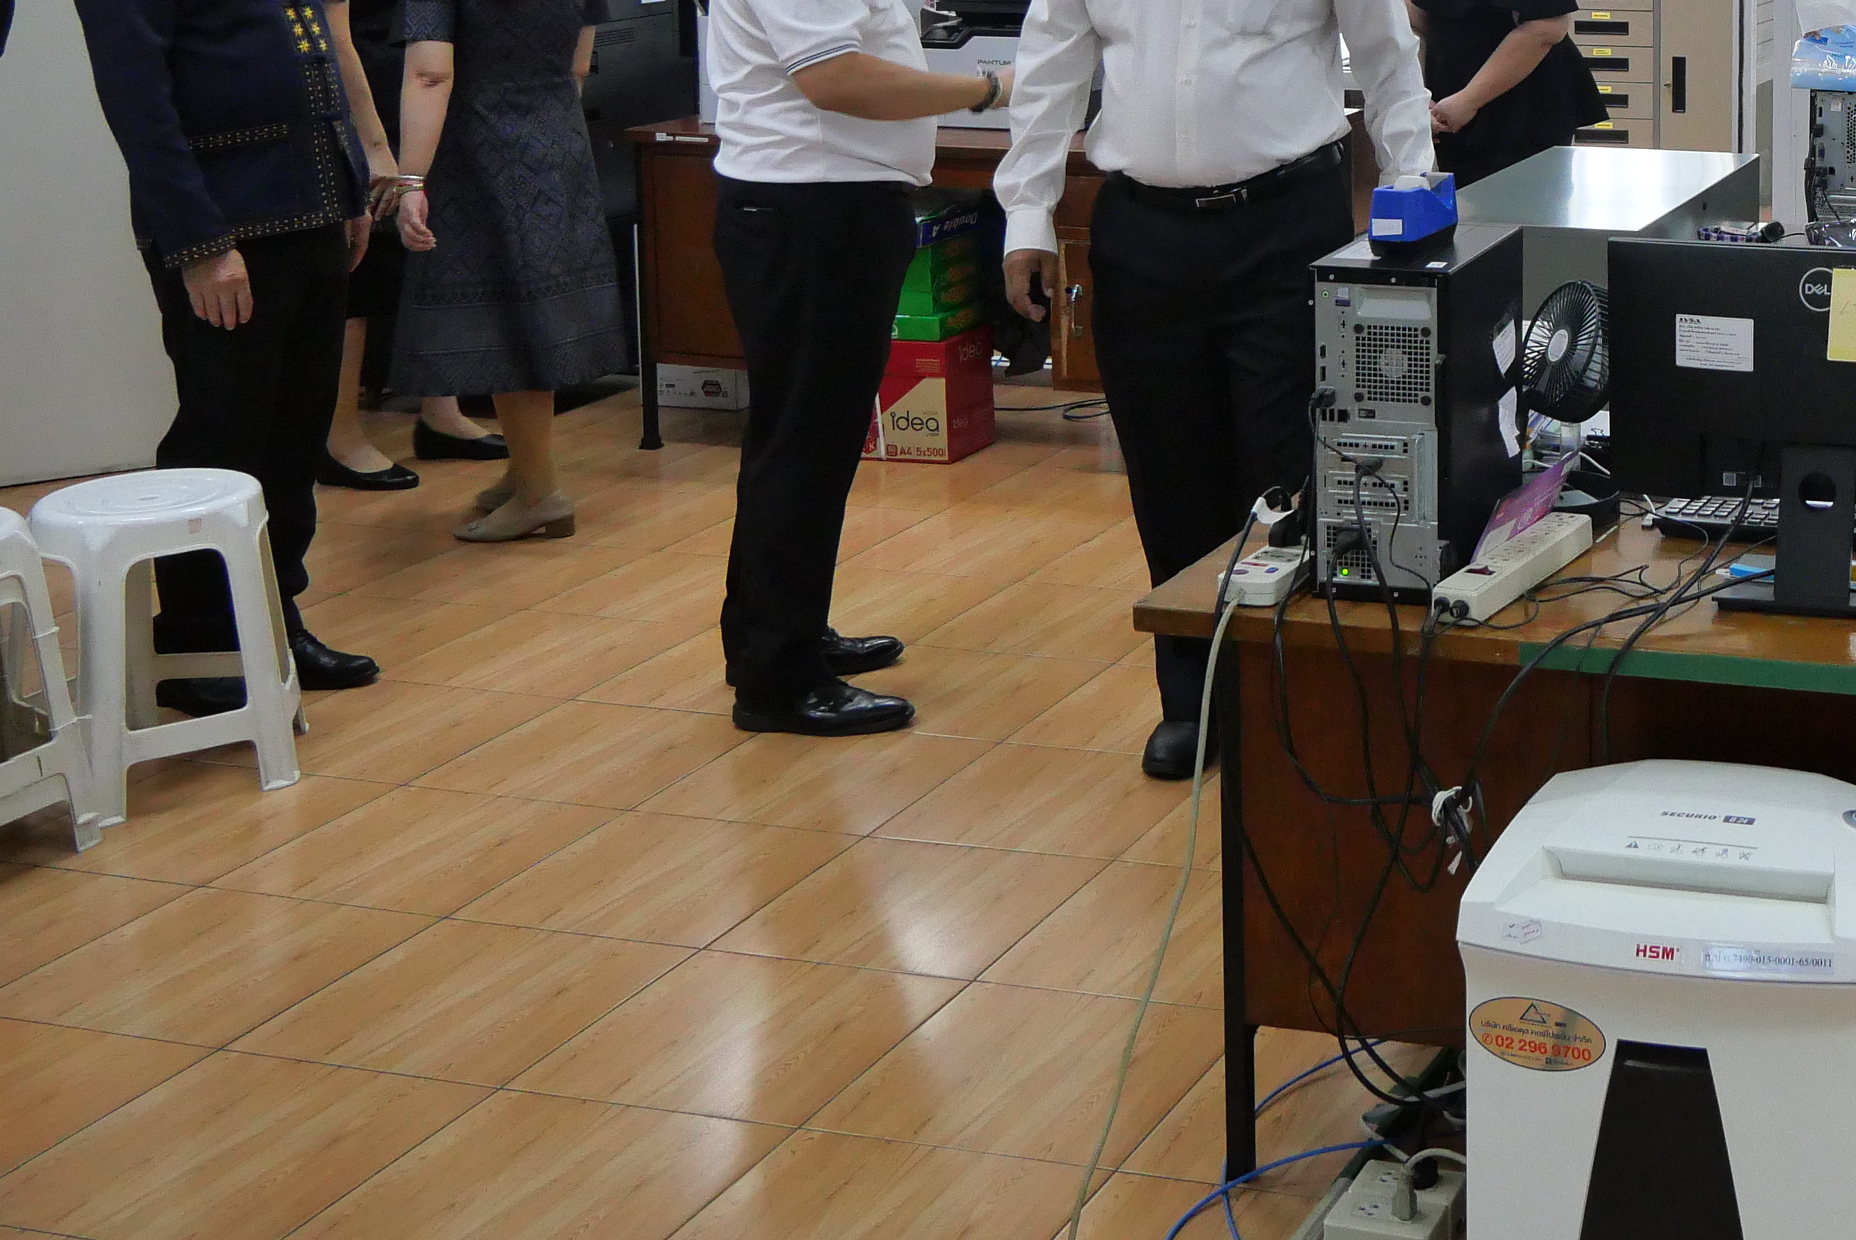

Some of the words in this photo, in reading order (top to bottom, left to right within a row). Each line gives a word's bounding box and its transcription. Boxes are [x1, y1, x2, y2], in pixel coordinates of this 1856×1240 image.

[931, 223, 941, 237] A
[1804, 283, 1830, 295] DEL
[889, 410, 939, 432] idea
[899, 446, 912, 456] A4
[1660, 811, 1717, 821] SECURIO
[1635, 943, 1675, 961] HSM
[1495, 1034, 1514, 1049] 02
[1518, 1038, 1548, 1055] 296
[1552, 1044, 1592, 1061] 9700
